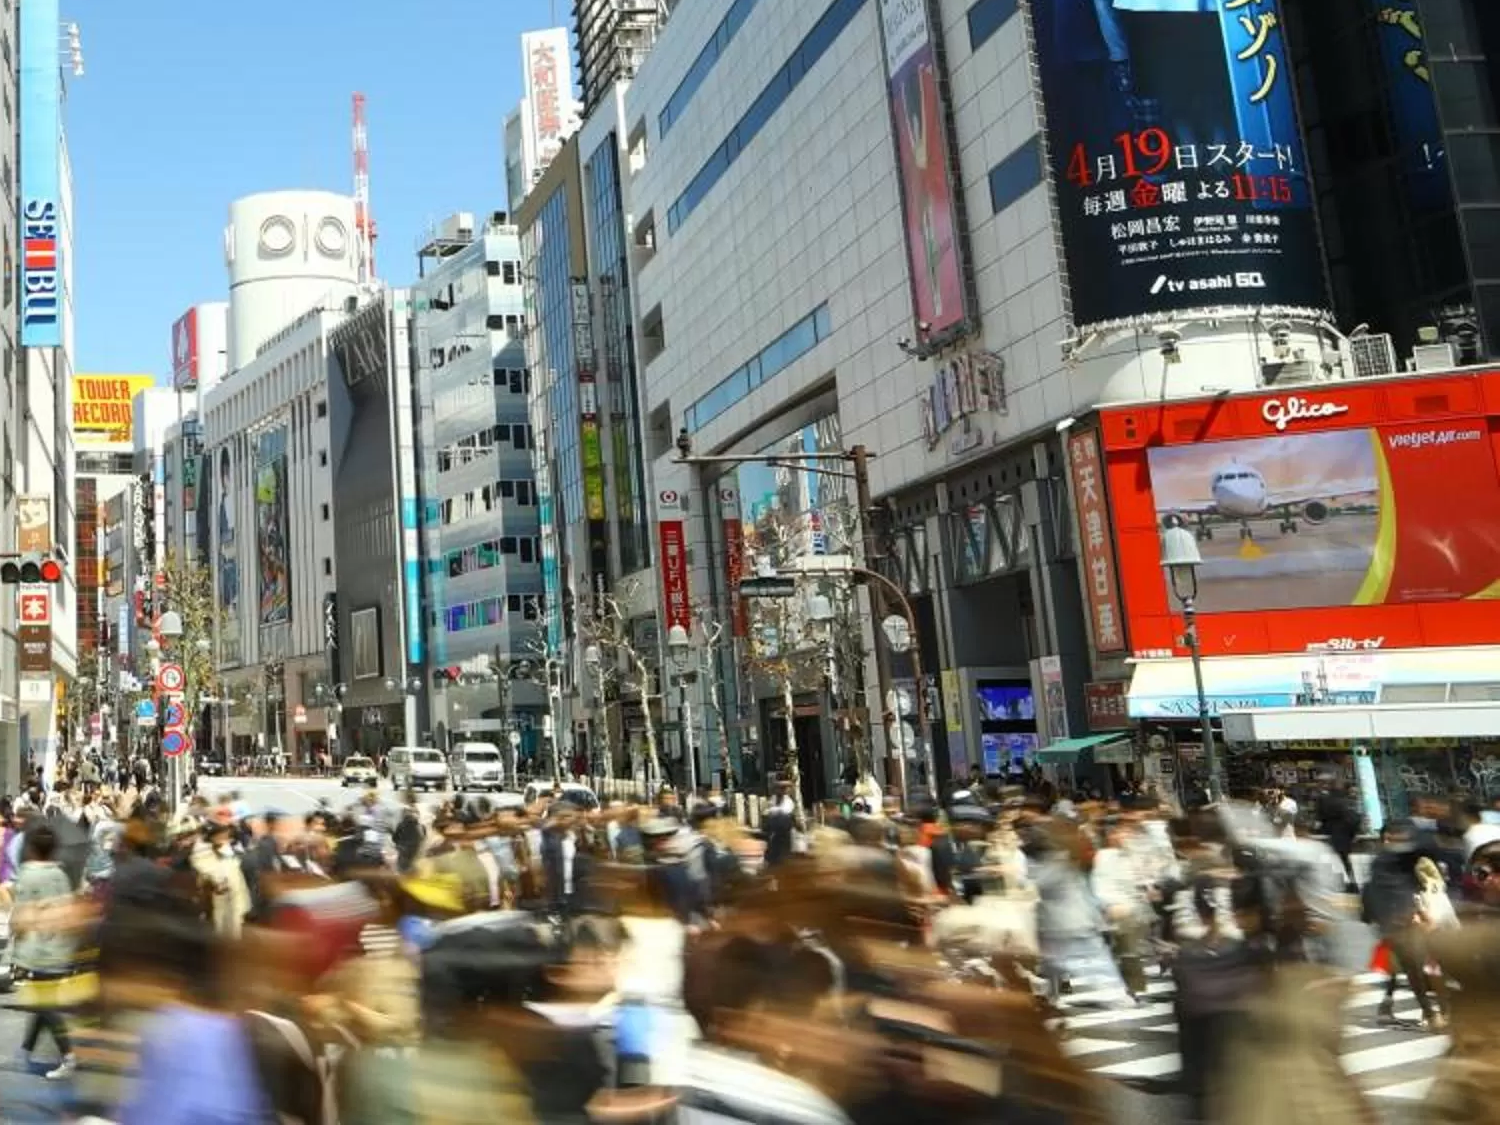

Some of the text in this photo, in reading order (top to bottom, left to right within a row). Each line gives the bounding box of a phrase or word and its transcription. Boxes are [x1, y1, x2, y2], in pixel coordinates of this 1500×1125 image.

[1167, 280, 1184, 292] tv
[1189, 275, 1233, 290] asahi
[76, 379, 130, 399] TOWER
[1262, 396, 1349, 430] Glico
